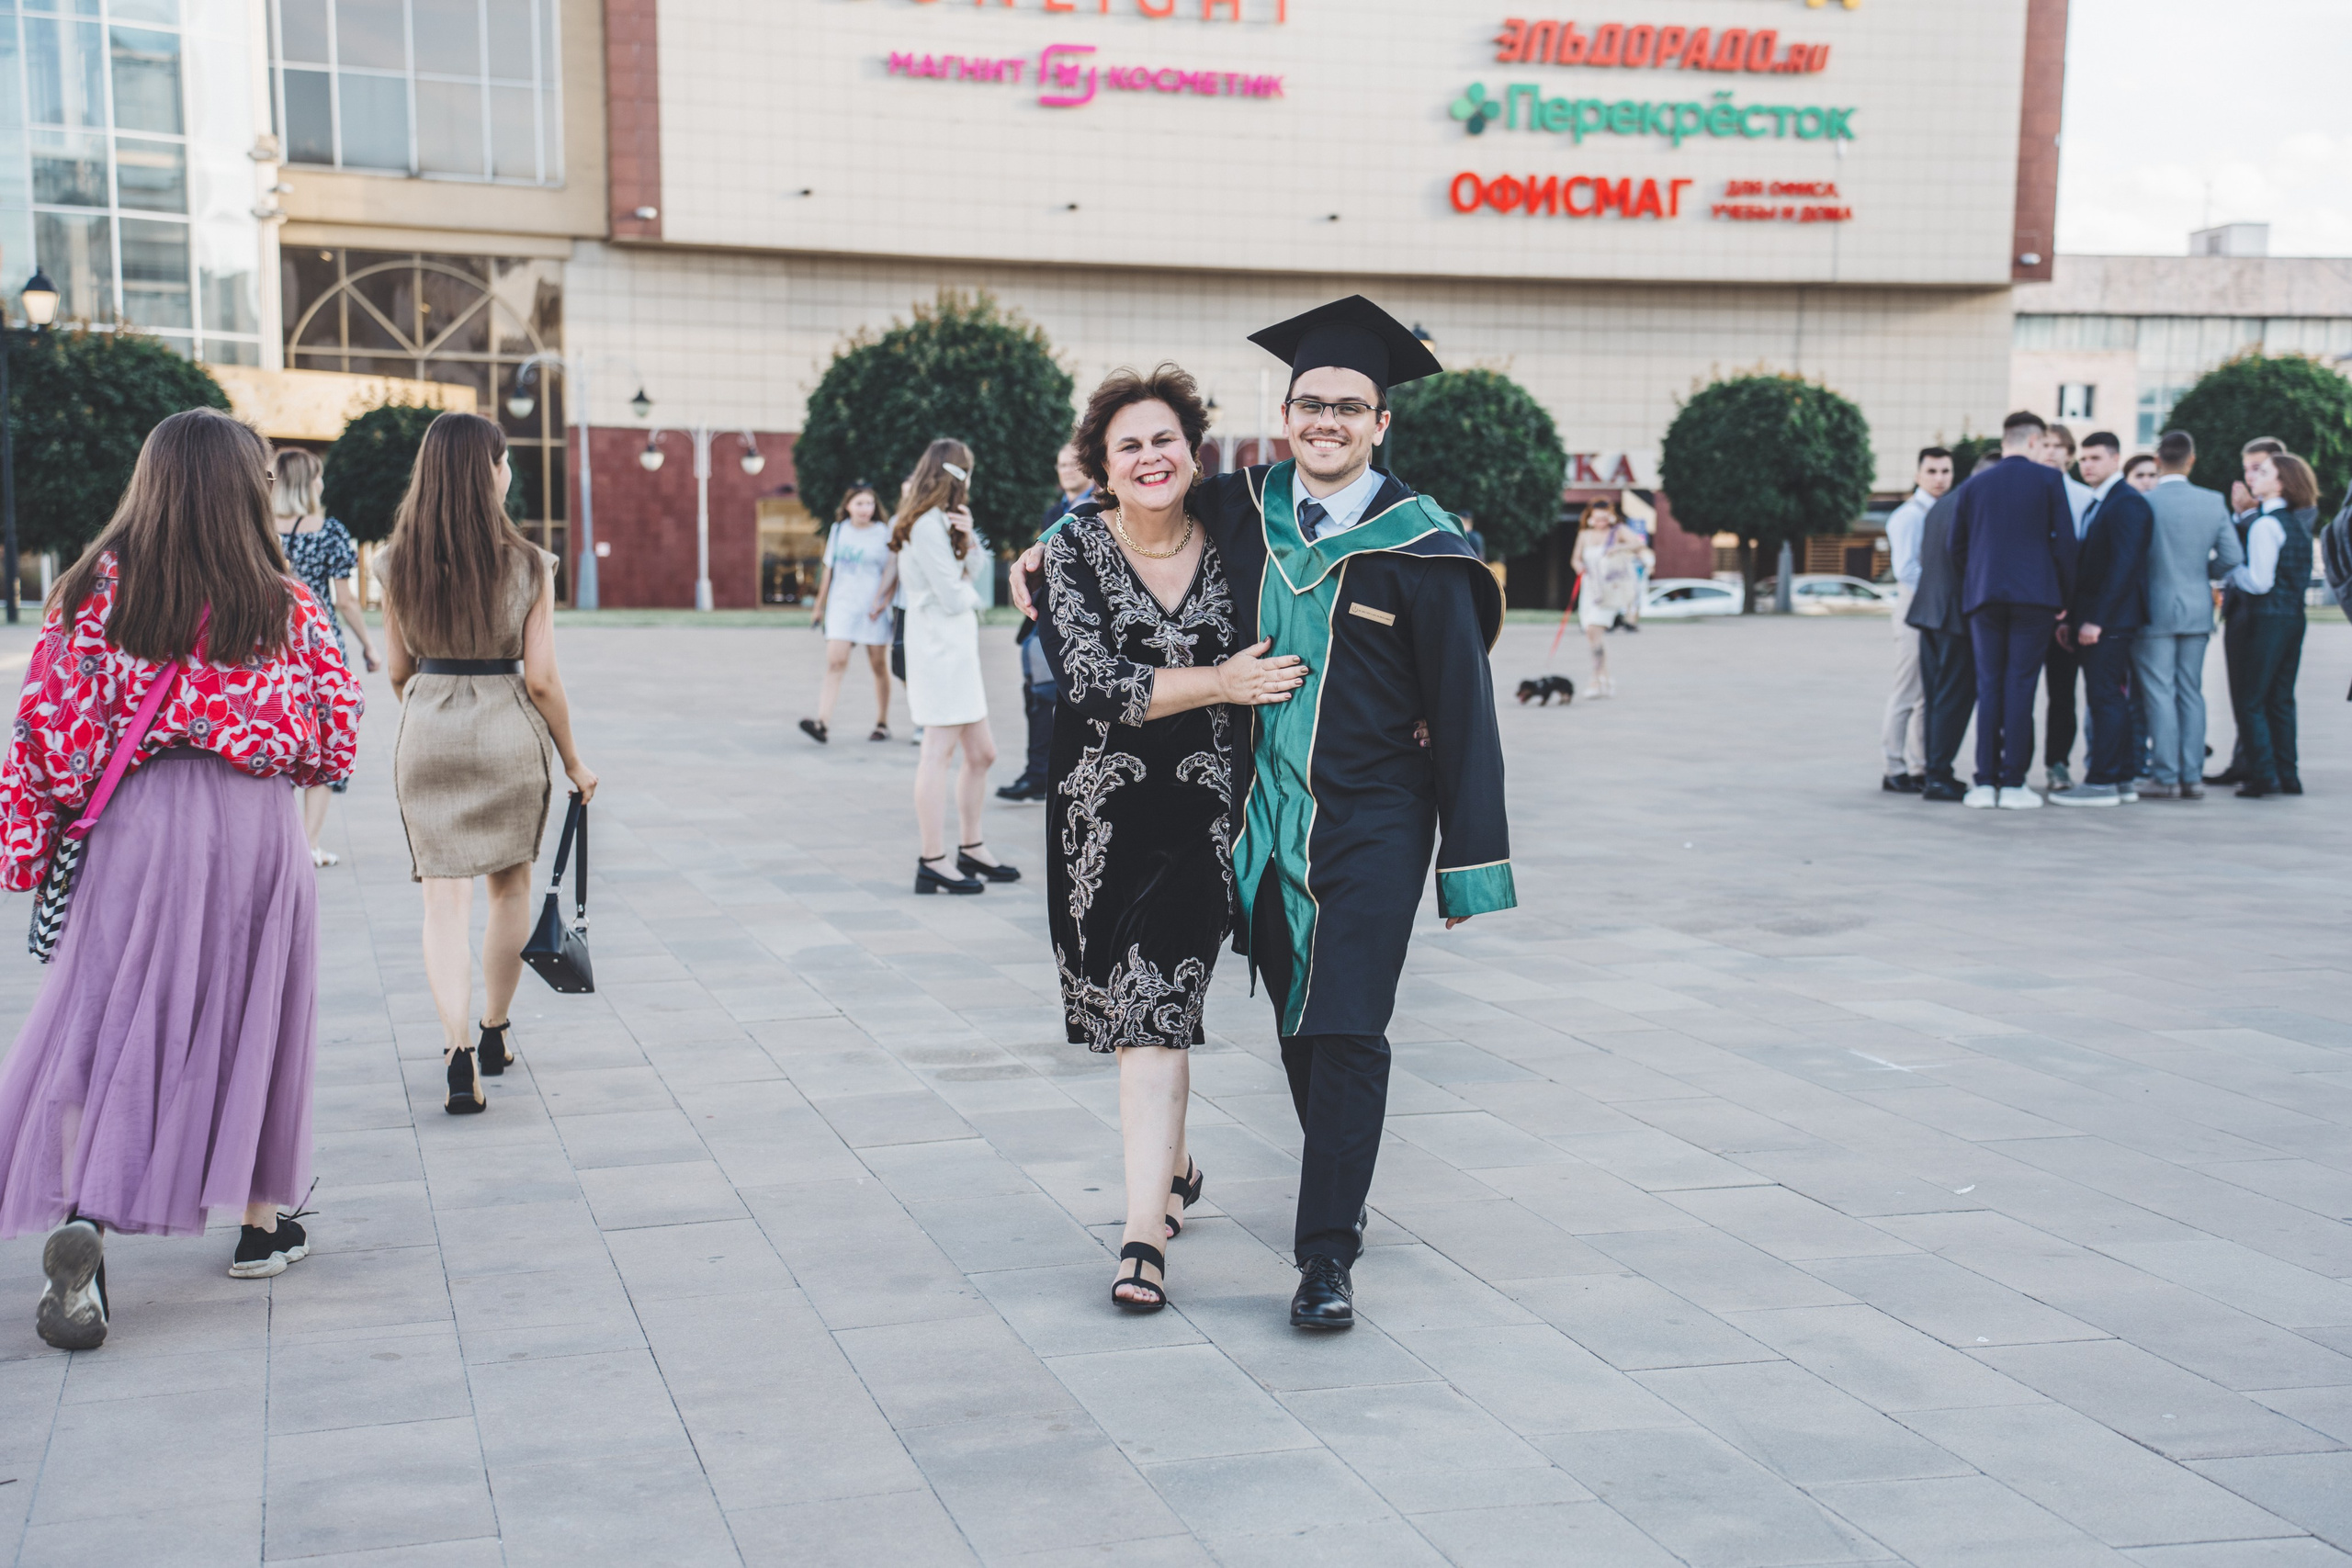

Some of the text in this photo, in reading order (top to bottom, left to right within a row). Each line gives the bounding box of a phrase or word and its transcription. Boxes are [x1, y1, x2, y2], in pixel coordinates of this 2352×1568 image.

[1494, 18, 1830, 74] ЭЛЬДОРАДО.RU
[888, 51, 1285, 98] МАГНИТ КОСМЕТИК
[1507, 84, 1856, 148] Перекрёсток
[1449, 172, 1692, 219] ОФИСМАГ
